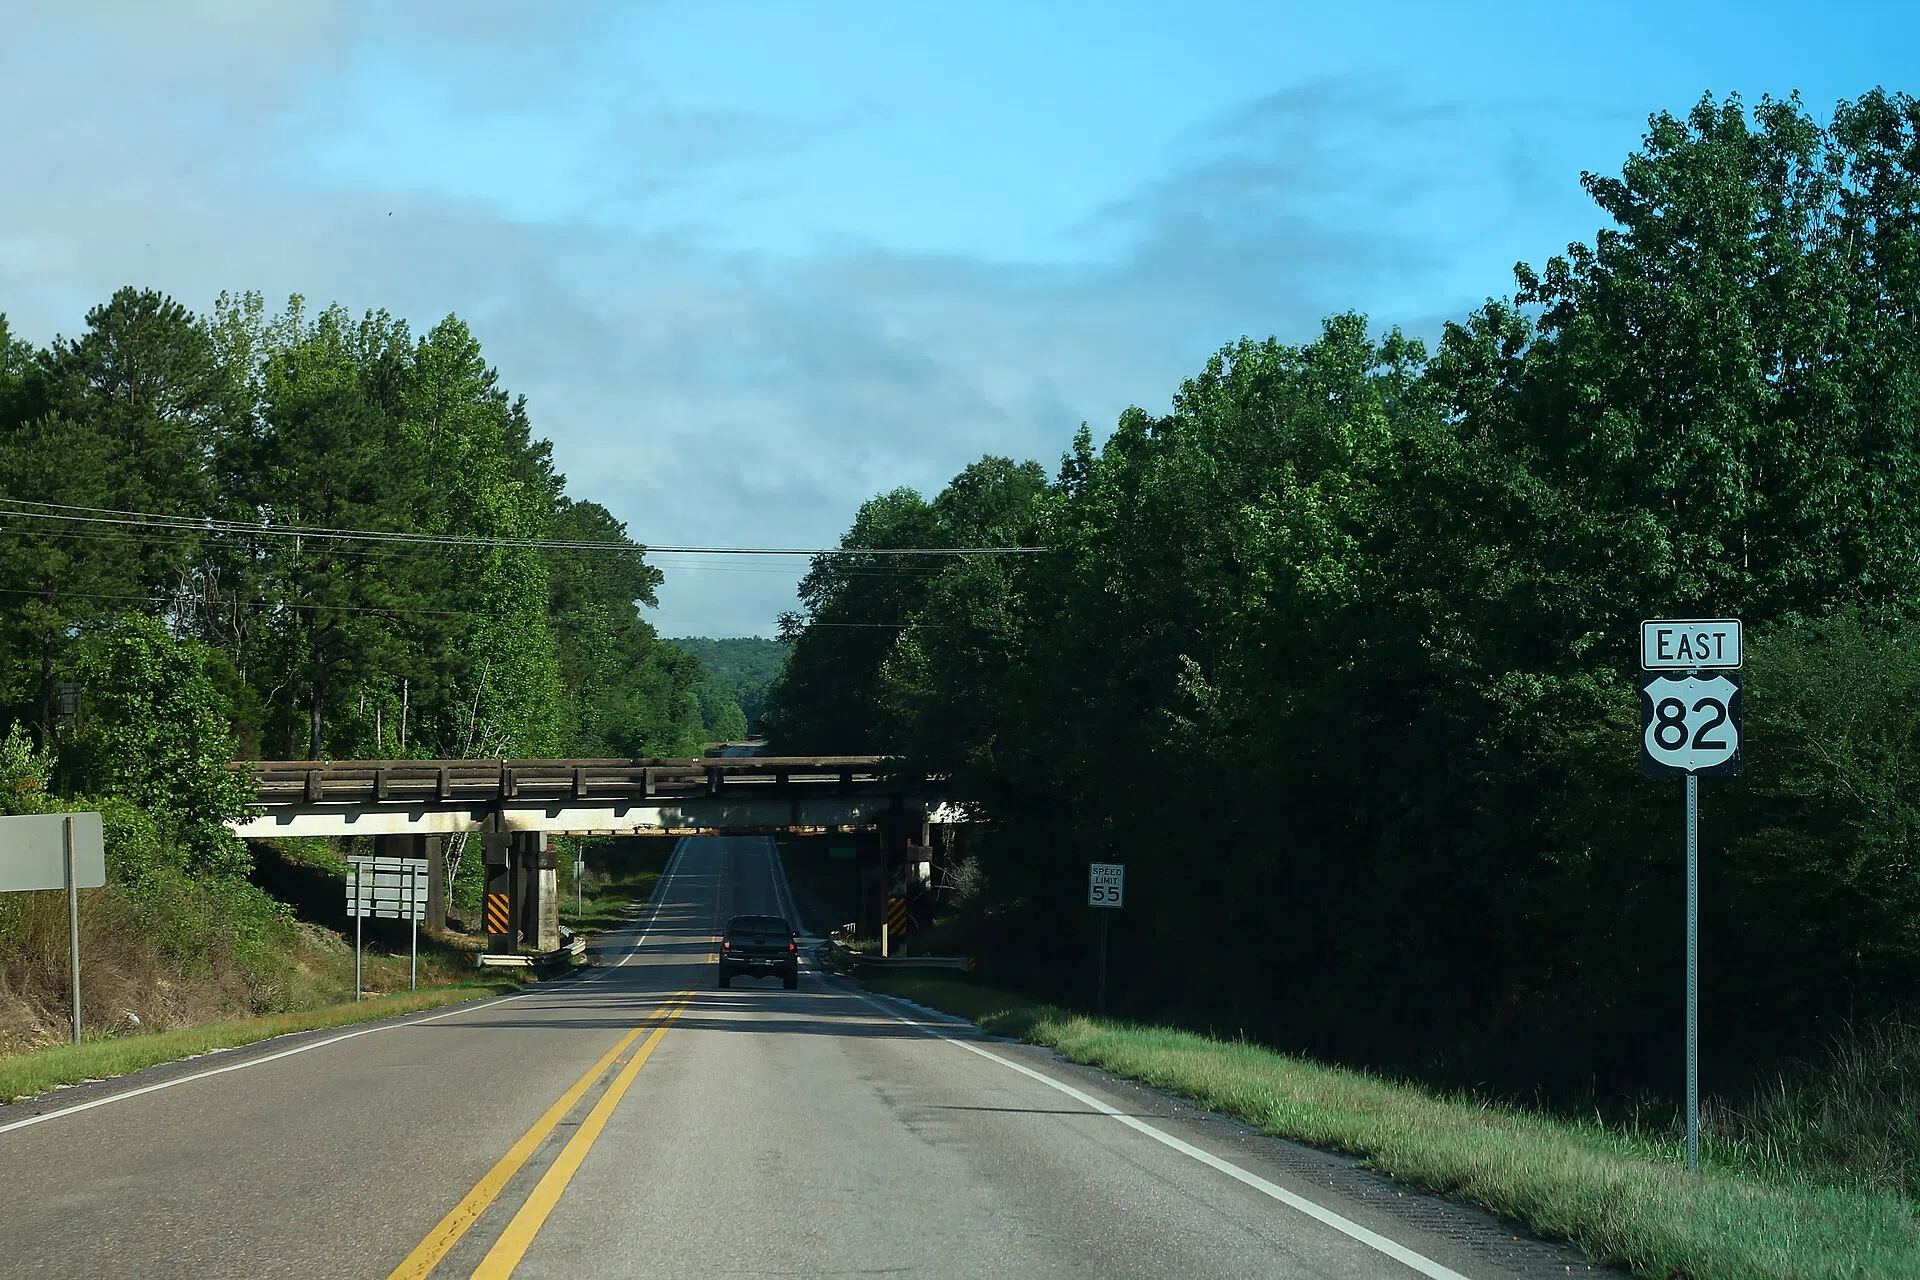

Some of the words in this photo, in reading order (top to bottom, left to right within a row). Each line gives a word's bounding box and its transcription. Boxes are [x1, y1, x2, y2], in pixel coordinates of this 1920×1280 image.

[1657, 629, 1726, 660] EAST
[1653, 697, 1727, 751] 82
[1092, 867, 1122, 876] SPEED
[1095, 877, 1118, 885] LIMIT
[1092, 885, 1120, 902] 55
